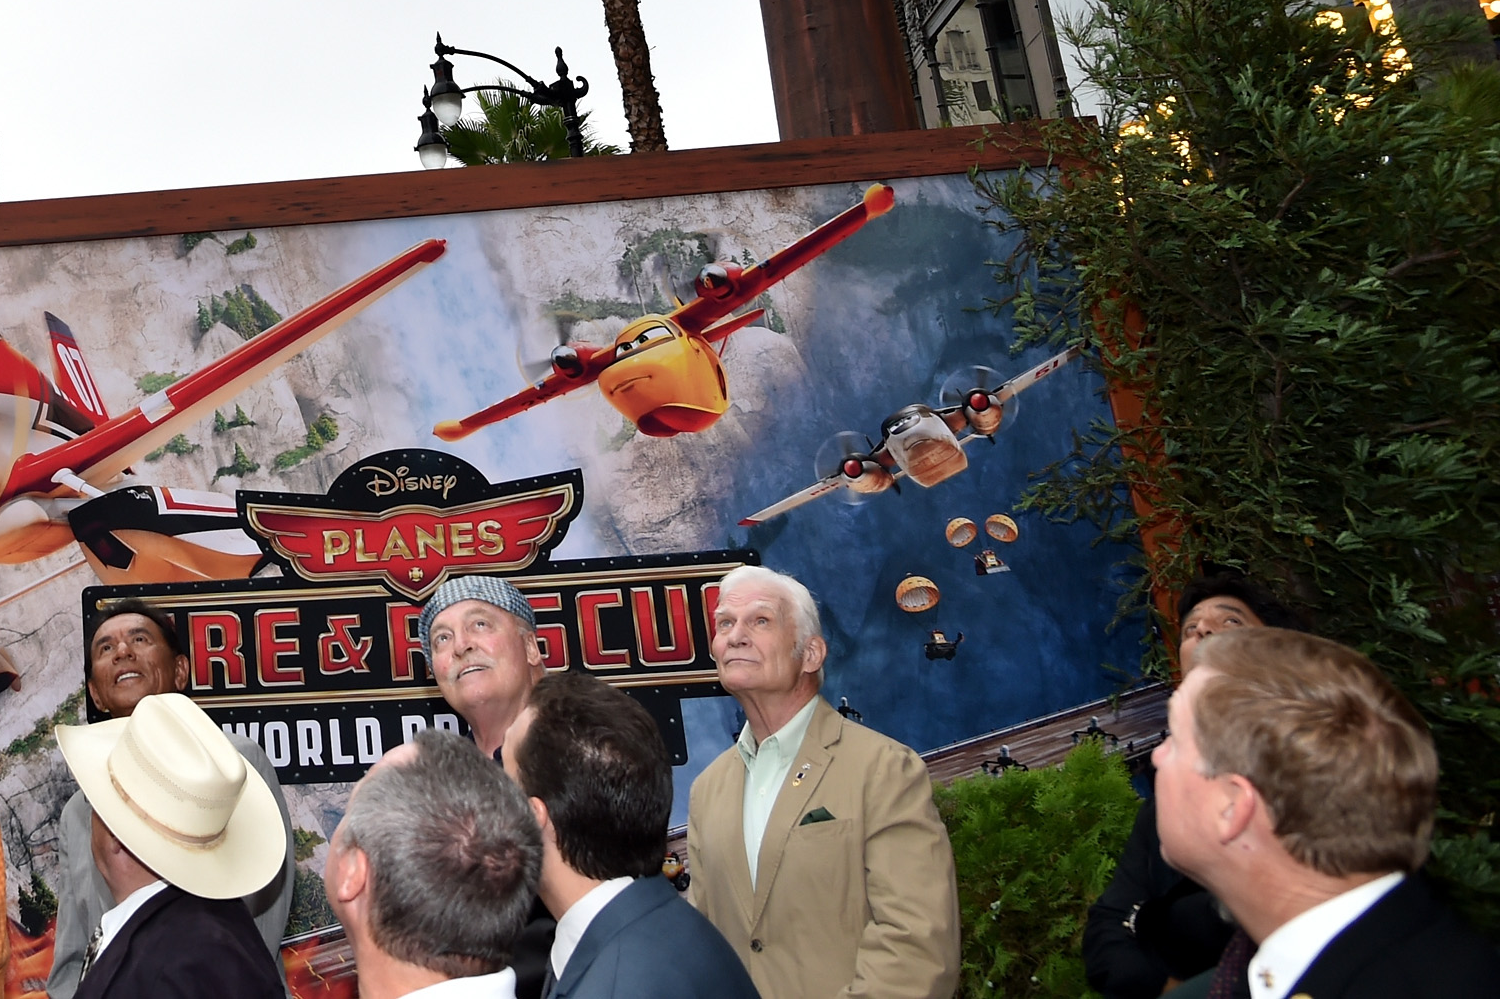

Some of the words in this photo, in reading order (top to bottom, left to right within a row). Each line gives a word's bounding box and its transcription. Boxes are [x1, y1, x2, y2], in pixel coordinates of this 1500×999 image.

[322, 519, 506, 565] PLANES
[167, 607, 306, 690] RE
[317, 613, 374, 676] &
[385, 582, 718, 682] RSCU
